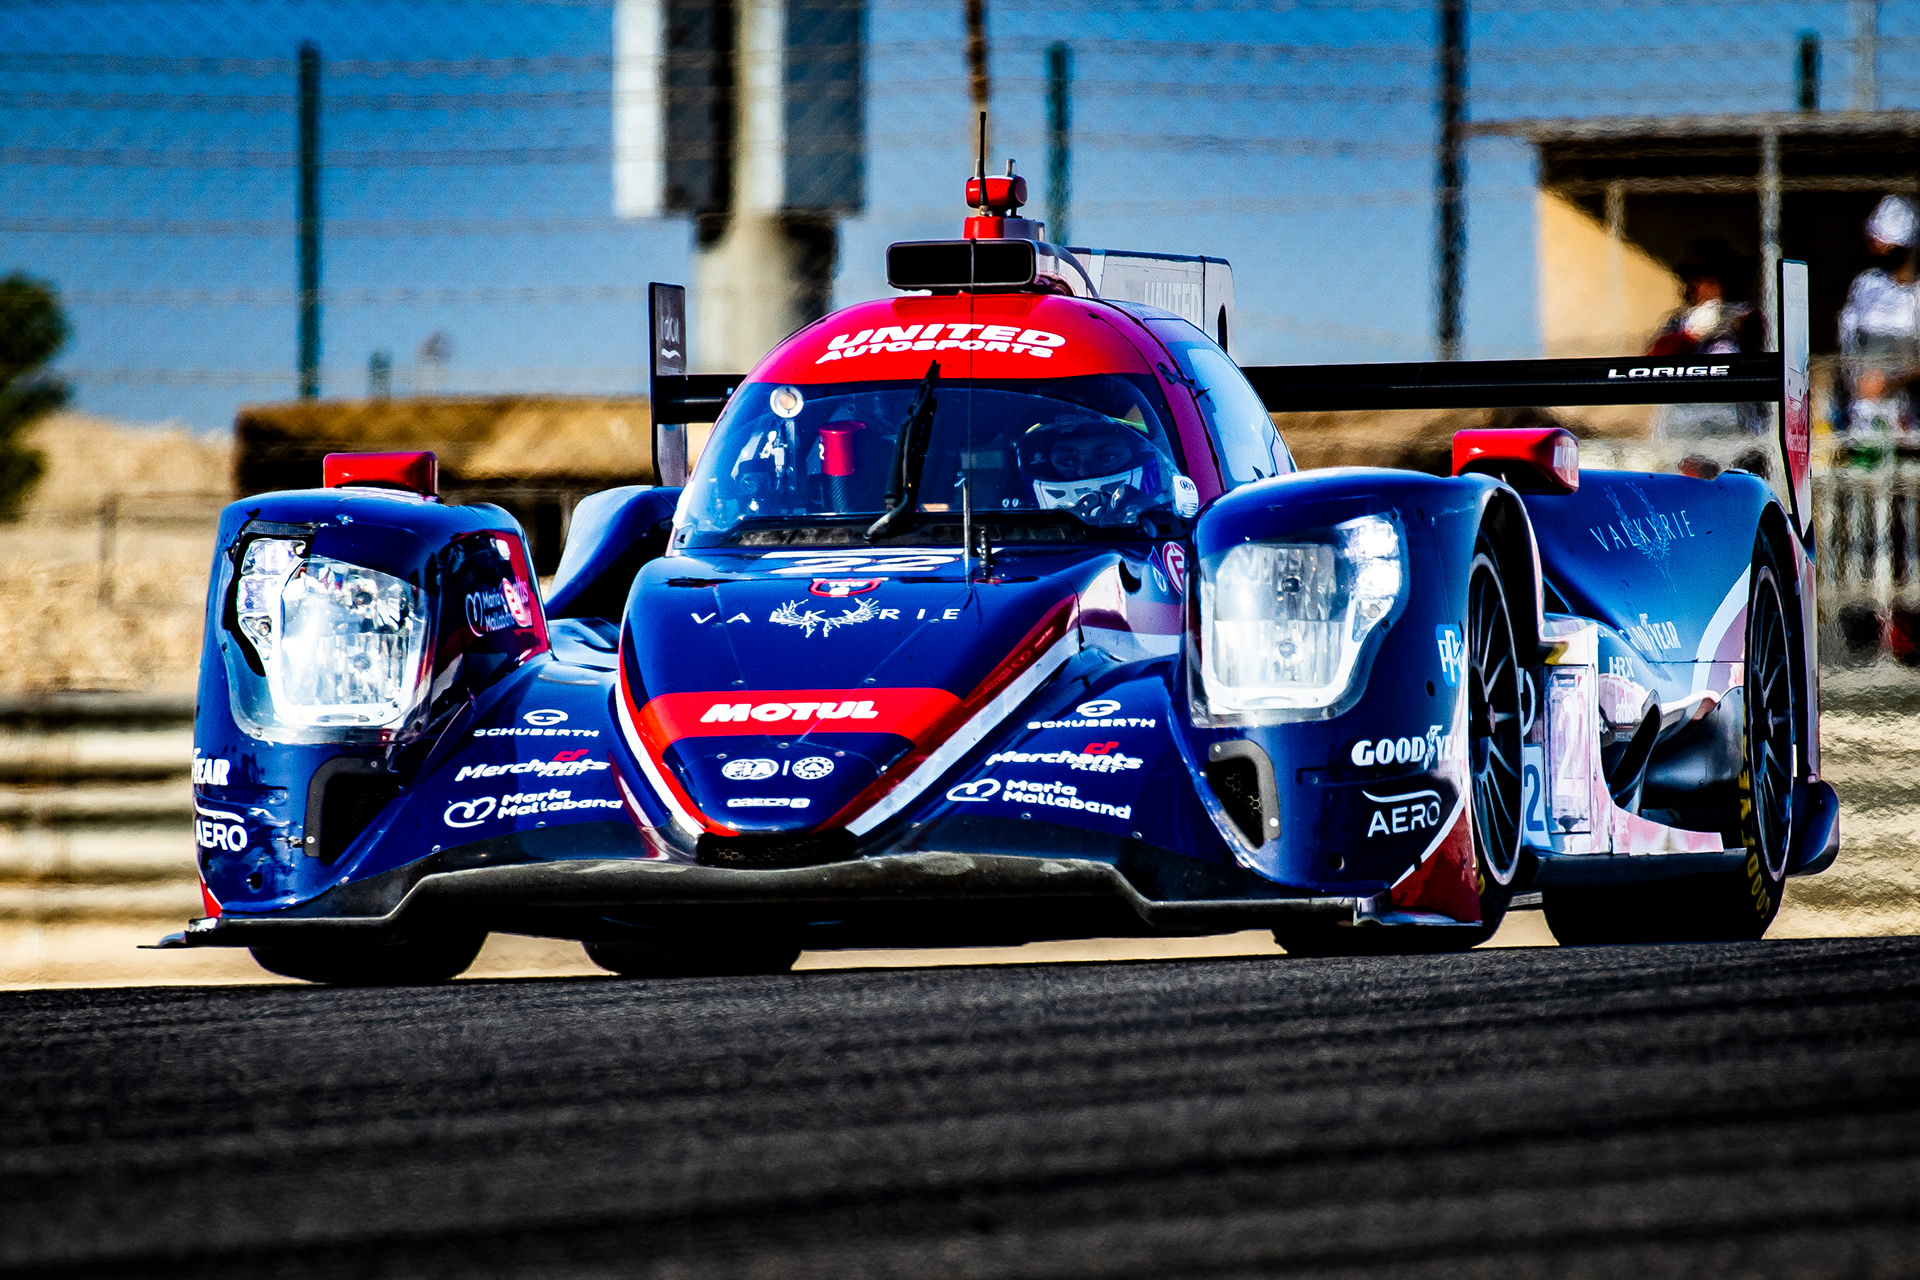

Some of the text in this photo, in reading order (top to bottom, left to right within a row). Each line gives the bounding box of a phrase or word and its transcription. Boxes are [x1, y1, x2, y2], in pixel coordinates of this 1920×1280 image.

[827, 323, 1066, 350] UNITED
[815, 339, 1054, 364] AUTOSPORTS
[1607, 365, 1730, 379] LORIGE
[1589, 510, 1696, 552] VALKYRIE
[767, 556, 958, 575] 22
[482, 587, 502, 610] Maria
[690, 607, 962, 624] VALKYRIE
[699, 700, 880, 723] MOTUL
[473, 727, 600, 738] SCHUBERTH
[1026, 718, 1157, 730] SCHUBERTH
[1351, 727, 1466, 768] GOODYEA
[454, 758, 611, 782] Merchants
[724, 760, 778, 779] FIA
[985, 750, 1144, 770] Merchants
[1070, 762, 1126, 774] FLEET
[501, 788, 572, 806] Maria
[1006, 779, 1078, 796] Maria
[497, 799, 624, 819] Mallaband
[1002, 790, 1132, 820] Mallaband
[1367, 800, 1441, 838] AERO
[195, 818, 248, 852] AERO
